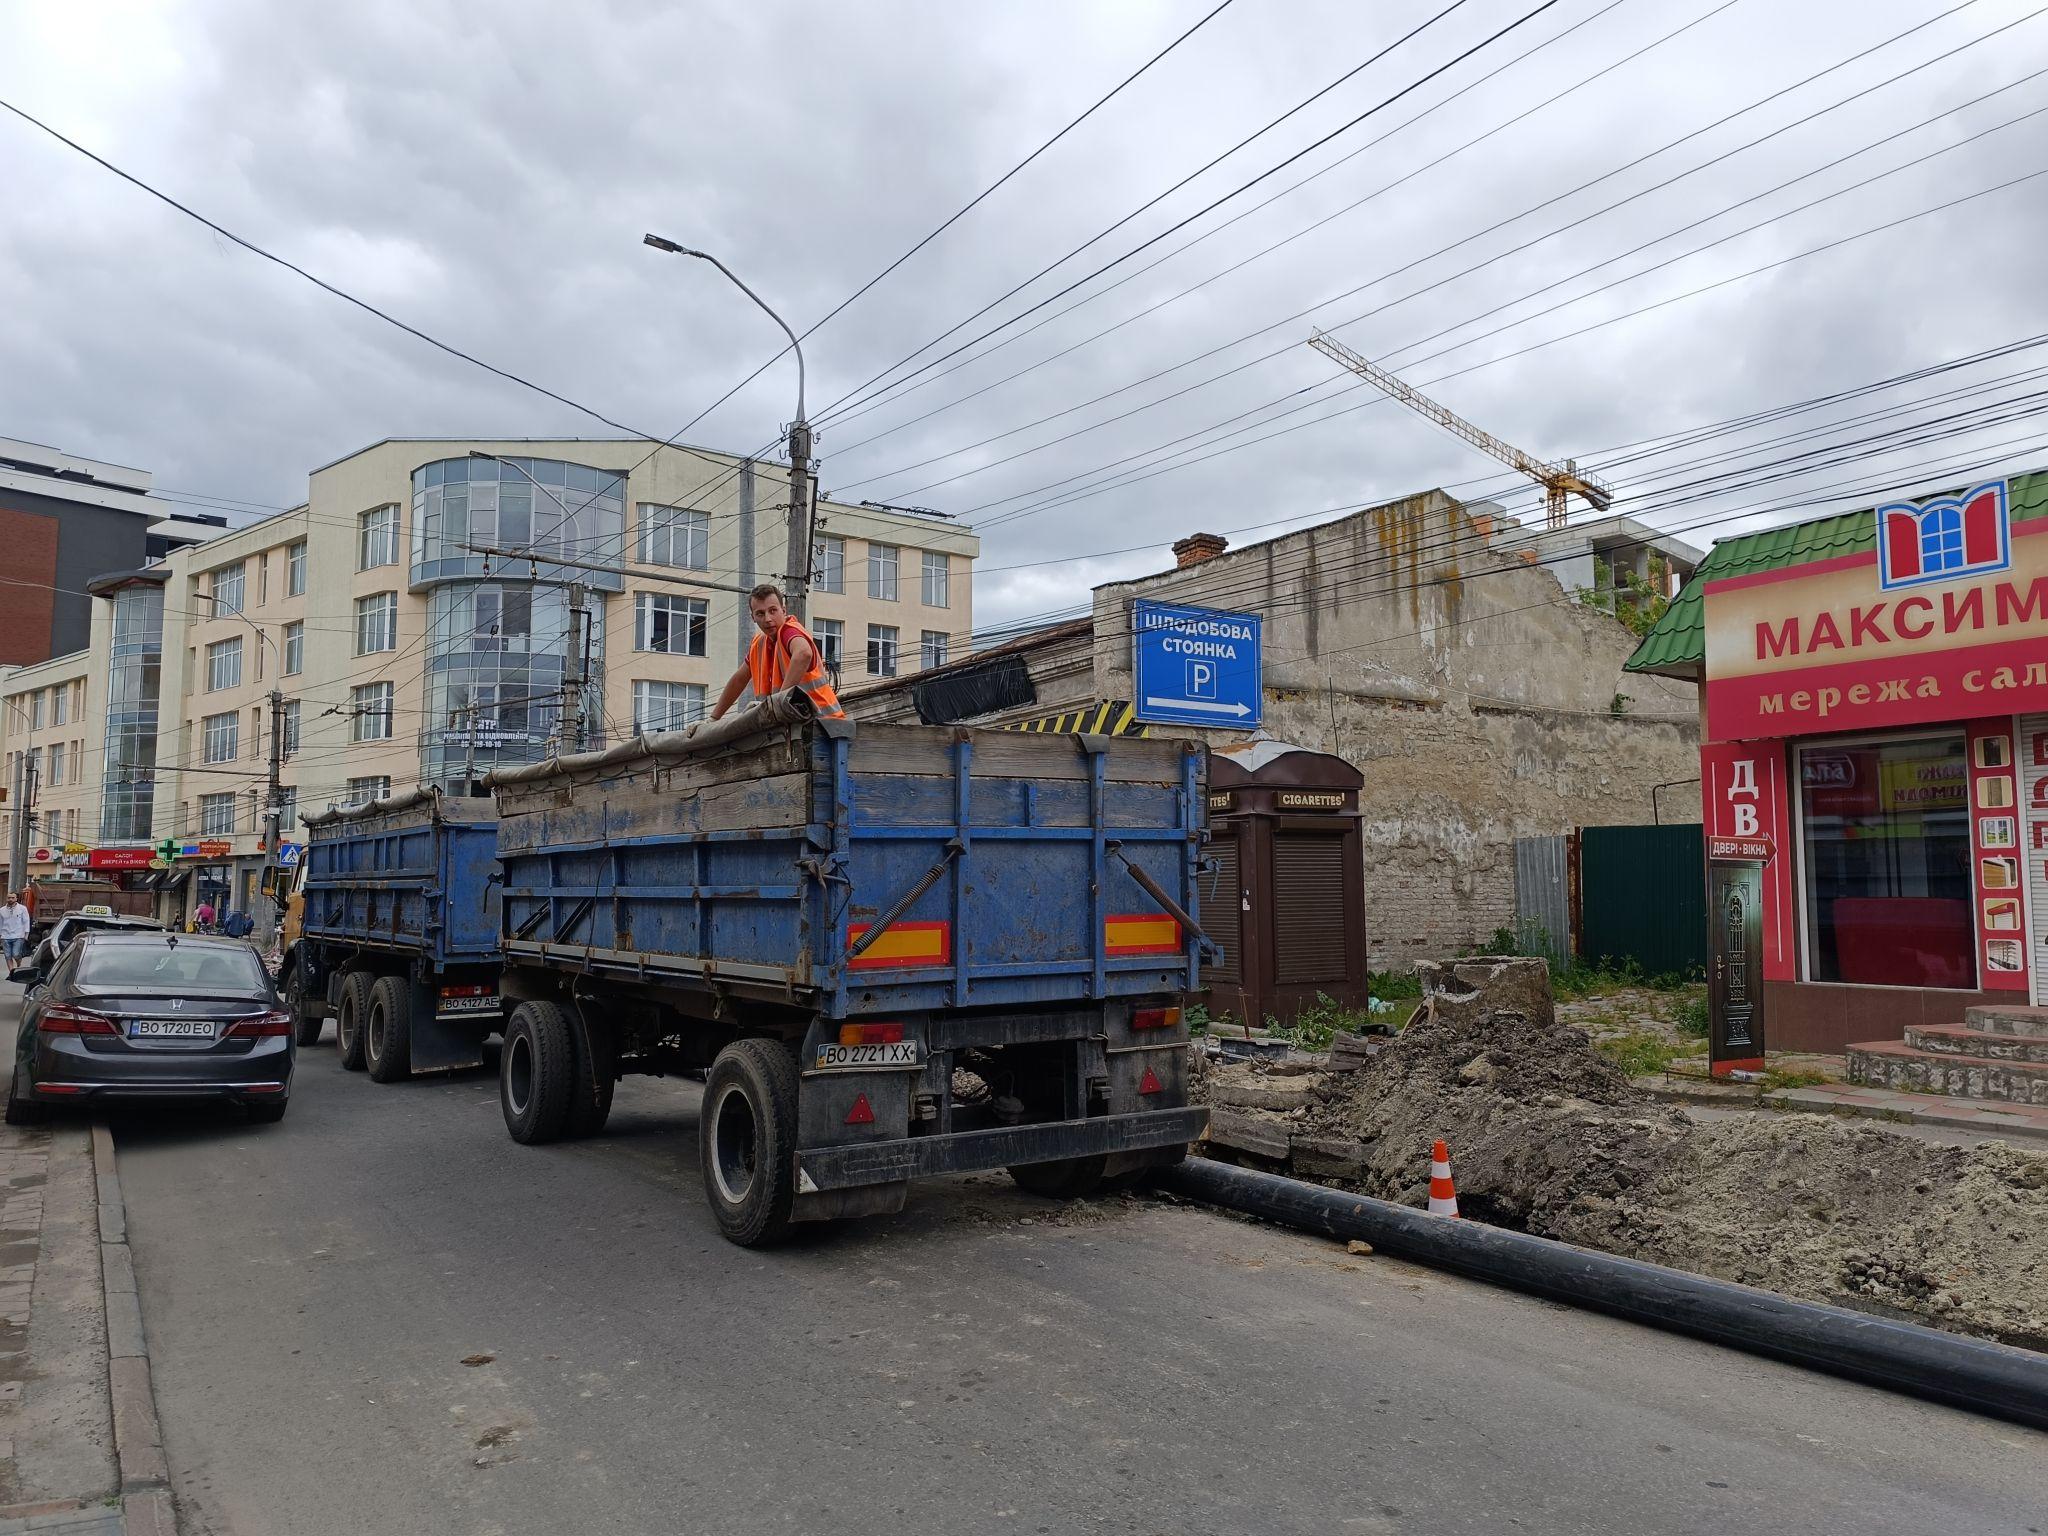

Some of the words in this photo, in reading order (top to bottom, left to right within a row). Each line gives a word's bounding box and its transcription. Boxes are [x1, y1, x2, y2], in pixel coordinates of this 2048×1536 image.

[1145, 613, 1252, 641] ЦІЛОДОБОВА
[1755, 577, 2048, 661] МАКСИМ
[1162, 638, 1236, 659] СТОЯНКА
[1758, 674, 1941, 717] мережа
[1962, 662, 2048, 693] сал
[467, 719, 496, 730] ЦНТР
[1712, 842, 1738, 856] ДВЕРІ
[1742, 843, 1767, 856] ВІКНА
[446, 999, 459, 1008] BO
[461, 998, 482, 1008] 4127
[484, 997, 499, 1007] AE
[140, 1022, 159, 1033] BO
[162, 1022, 190, 1034] 1720
[193, 1023, 212, 1034] EO
[827, 1047, 848, 1064] BO
[851, 1045, 886, 1062] 2721
[889, 1044, 912, 1061] XX
